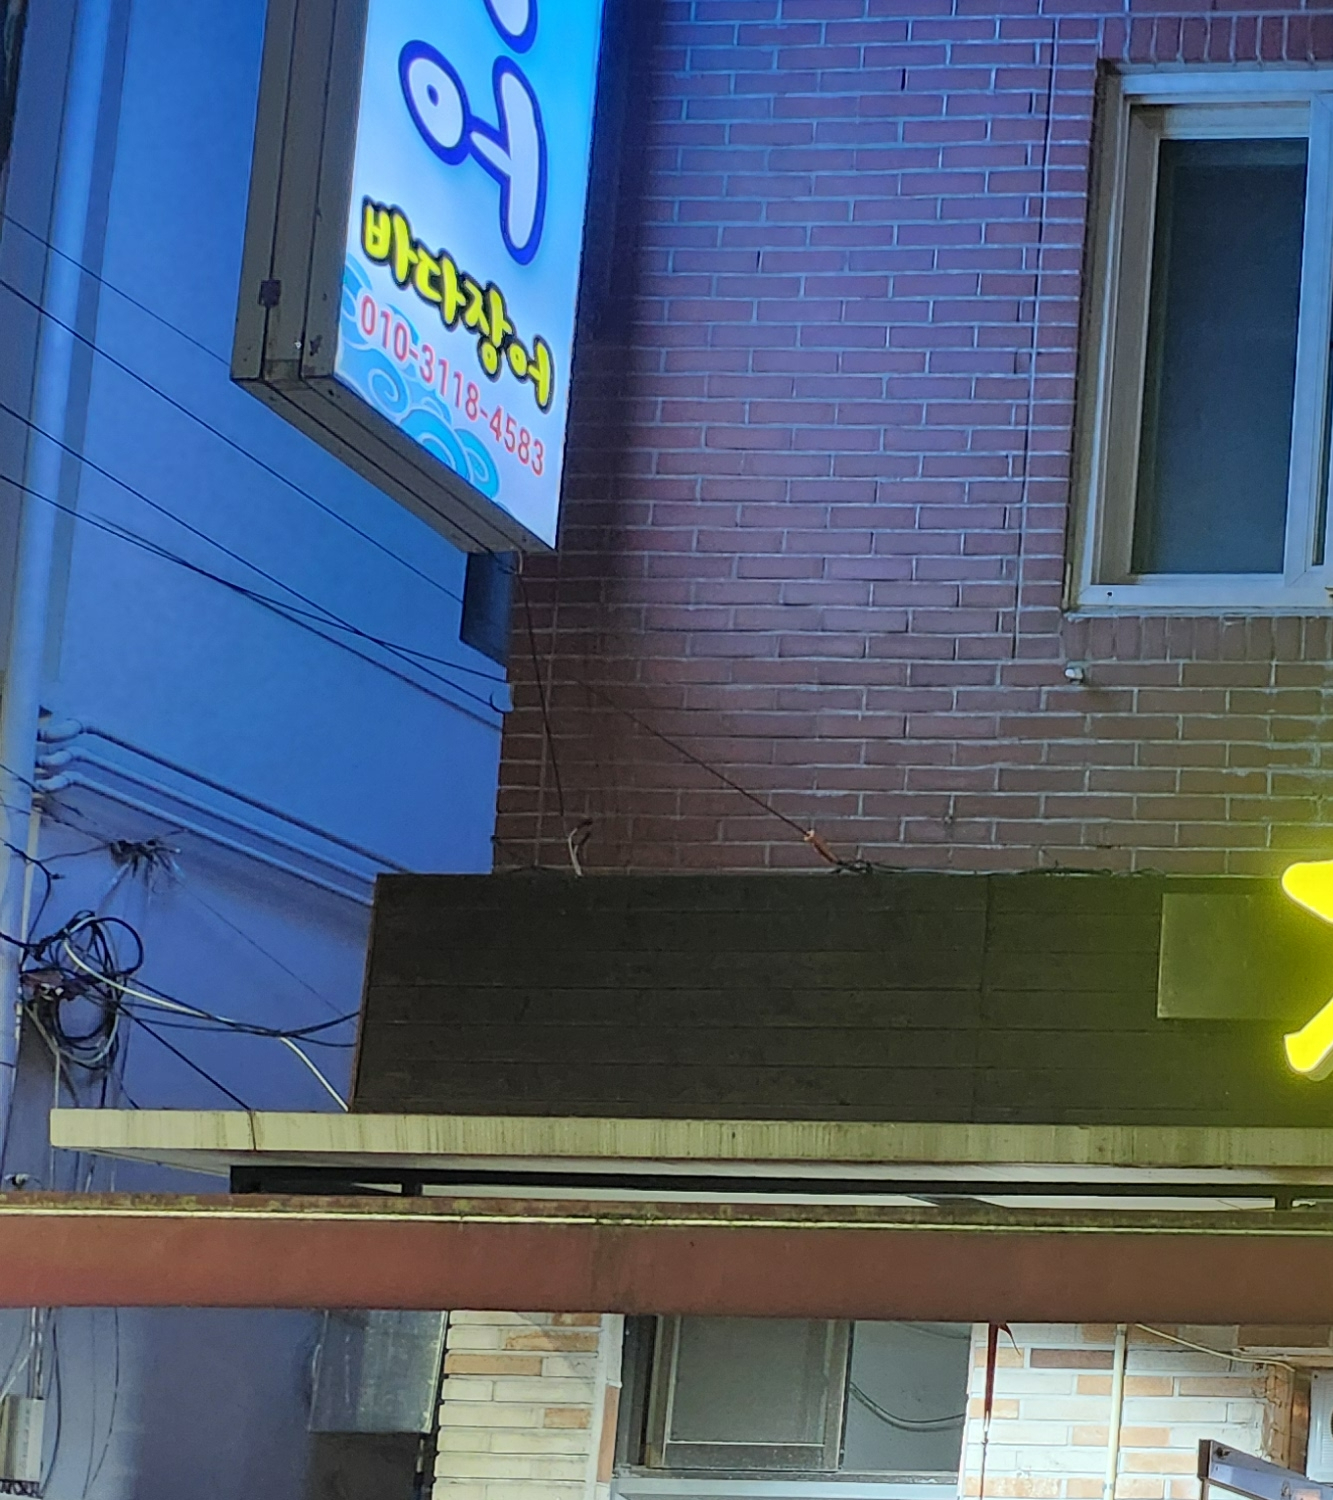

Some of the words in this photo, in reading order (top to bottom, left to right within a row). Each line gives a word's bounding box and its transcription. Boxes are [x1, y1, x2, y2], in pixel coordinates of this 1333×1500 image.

[399, 0, 548, 265] 어
[361, 295, 546, 477] 010-3118-4583
[362, 198, 554, 412] 바다장어
